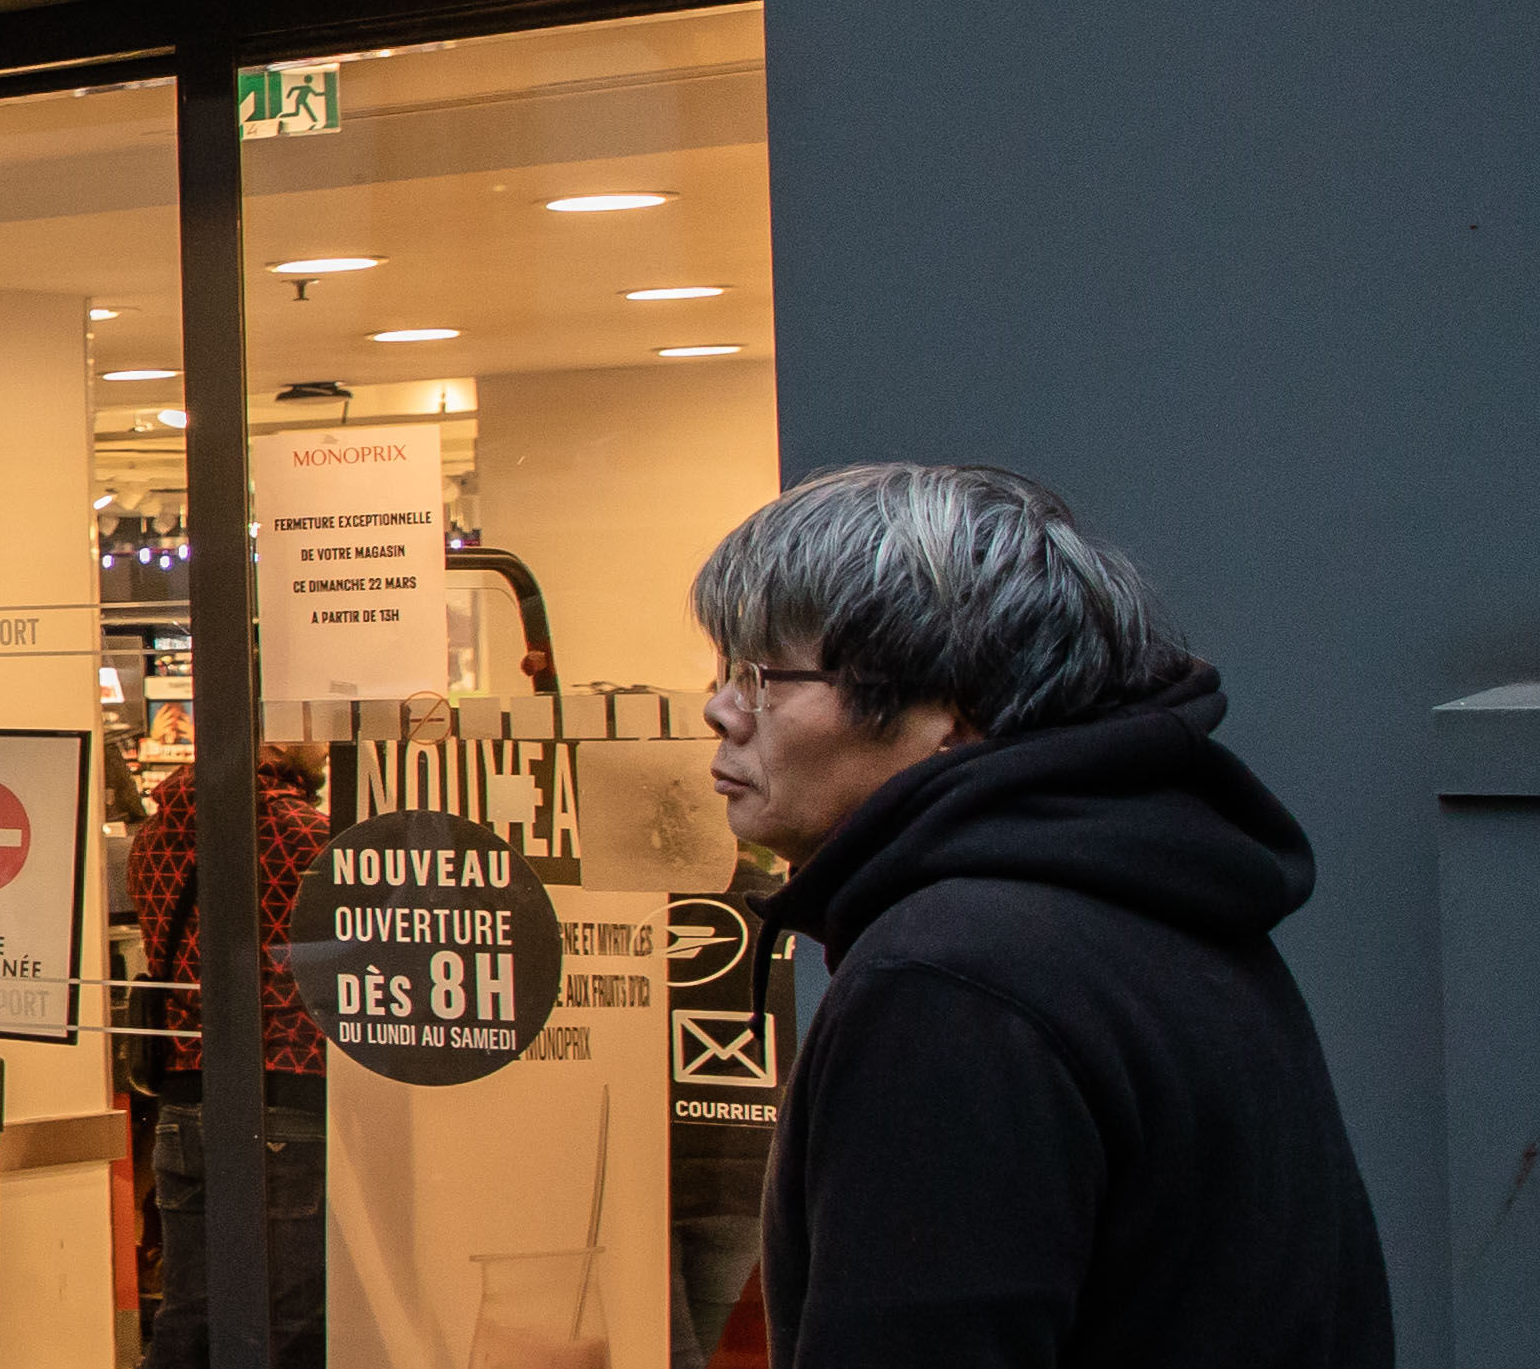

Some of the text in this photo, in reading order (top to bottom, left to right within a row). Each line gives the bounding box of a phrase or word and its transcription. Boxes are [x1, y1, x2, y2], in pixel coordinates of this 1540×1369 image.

[292, 444, 407, 467] MONOPRIX
[274, 511, 432, 532] FERMETURE EXCEPTIONNELLE
[301, 545, 405, 561] DE VOTRE MAGASIN
[293, 576, 417, 594] CE DIMANCHE 22 MARS
[322, 610, 359, 624] PARTIR
[362, 610, 377, 622] DE
[380, 609, 399, 622] 13H
[333, 849, 509, 887] NOUVEAU
[335, 907, 512, 945] OUVERTURE
[582, 923, 595, 955] ET
[337, 951, 515, 1021] DÈS 8H
[567, 975, 590, 1007] AUX
[339, 1021, 516, 1051] DU LUNDI AU SAMEDI
[676, 1101, 777, 1122] COURRIER
